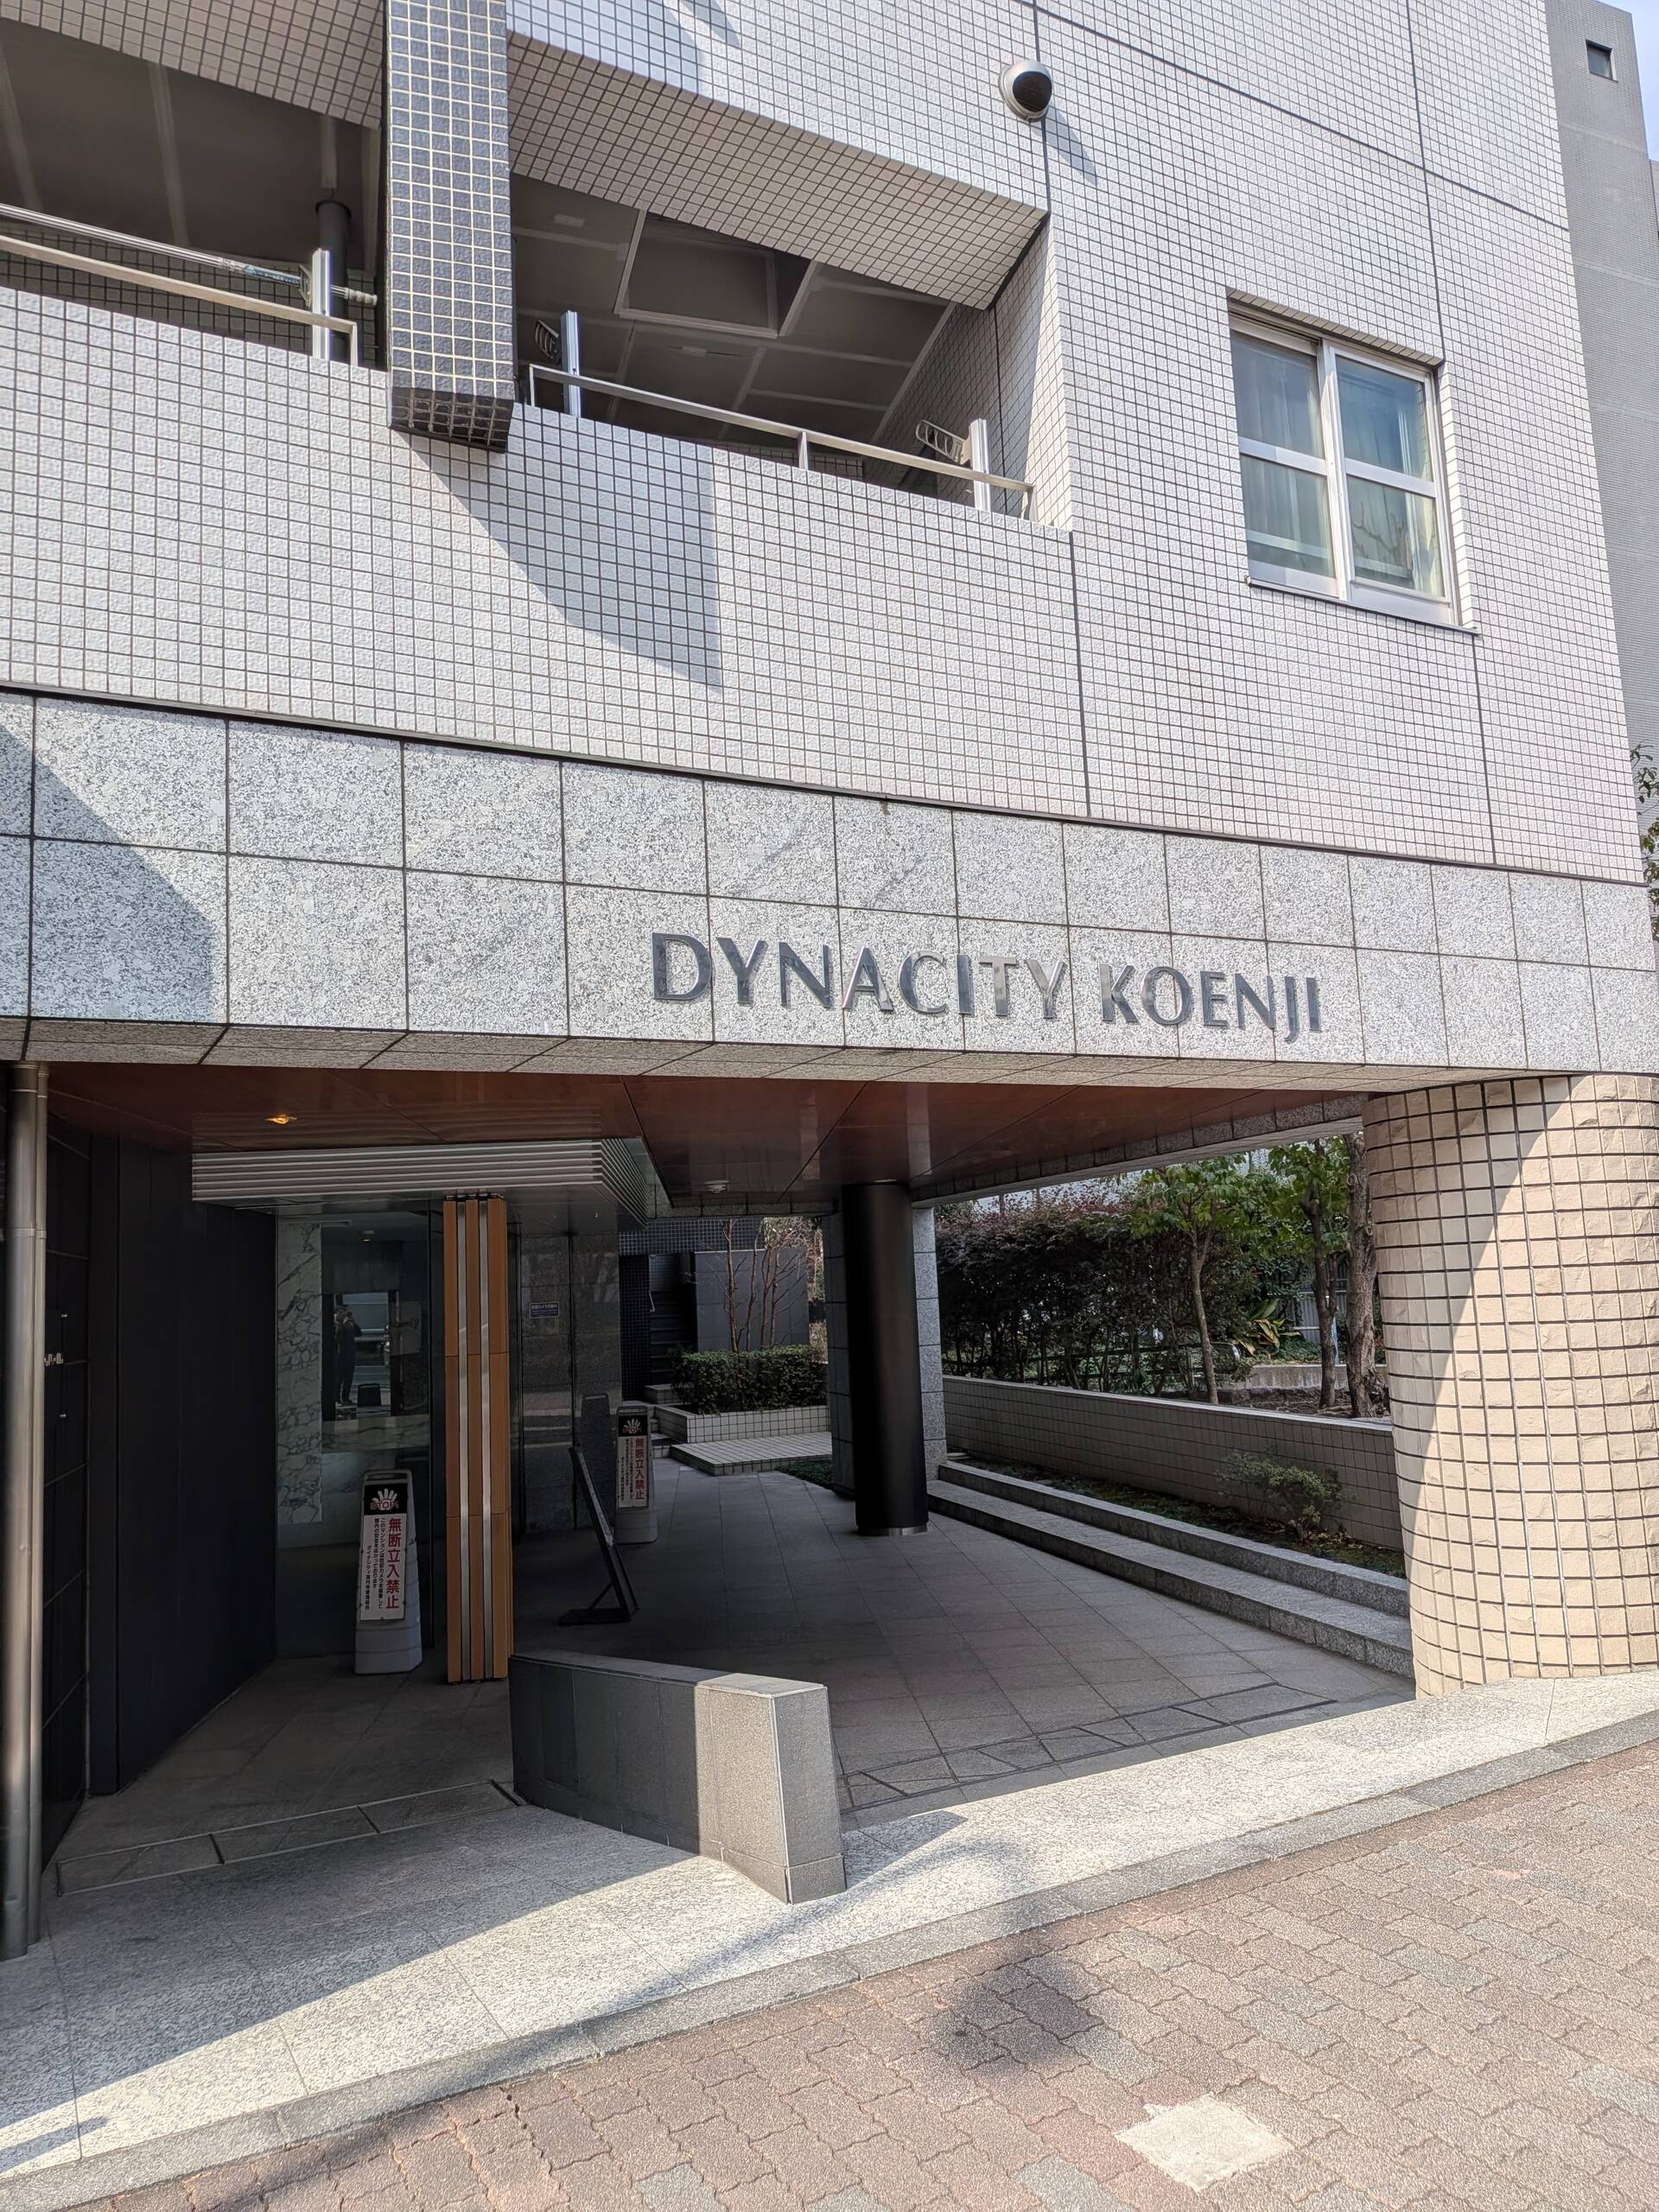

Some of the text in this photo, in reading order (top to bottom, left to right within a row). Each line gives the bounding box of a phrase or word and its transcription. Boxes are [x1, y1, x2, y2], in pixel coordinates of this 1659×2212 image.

[652, 932, 1321, 1041] DYNACITY KOENJI
[635, 1439, 644, 1499] 無断立入禁止
[386, 1518, 402, 1609] 無断立入禁止
